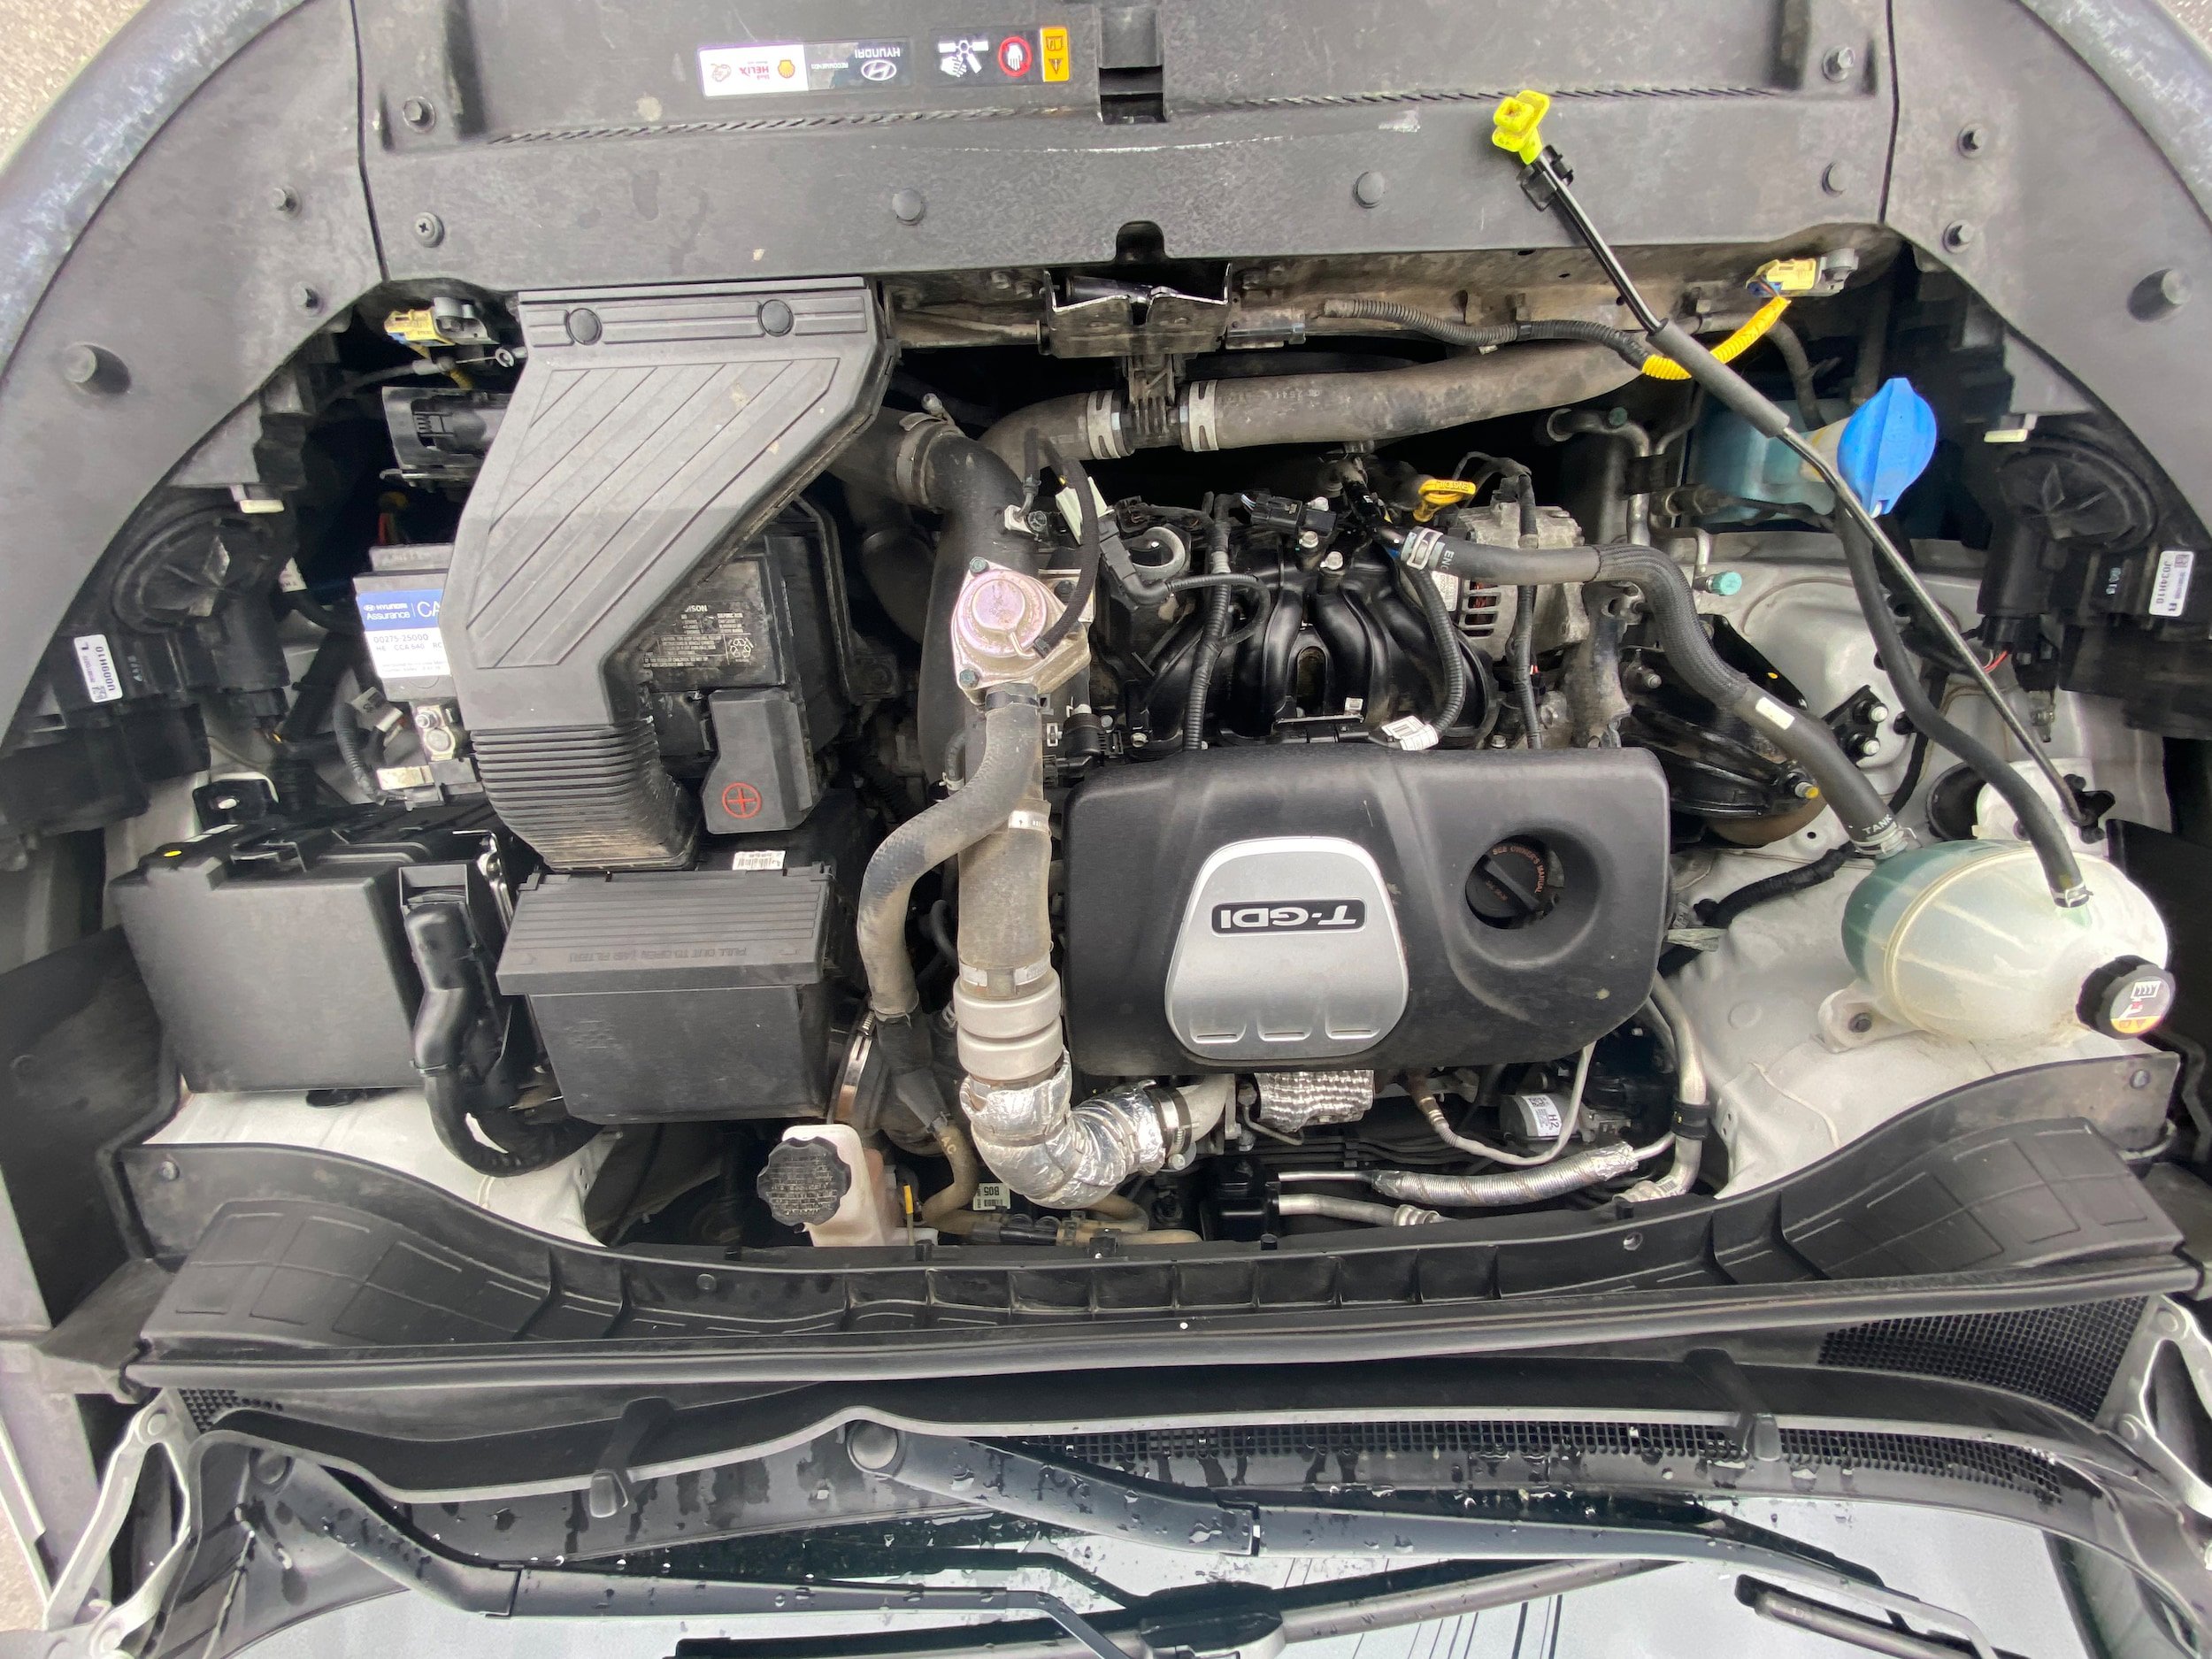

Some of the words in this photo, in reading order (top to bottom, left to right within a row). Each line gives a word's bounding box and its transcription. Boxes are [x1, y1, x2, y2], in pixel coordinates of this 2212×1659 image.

[855, 47, 901, 58] HYUNDAI
[739, 65, 769, 77] HELIX
[366, 611, 411, 620] Assurance
[1862, 813, 1893, 834] TANK
[1534, 865, 1545, 894] MANUAL
[1221, 904, 1357, 929] T-GDI
[984, 1186, 1000, 1196] B05
